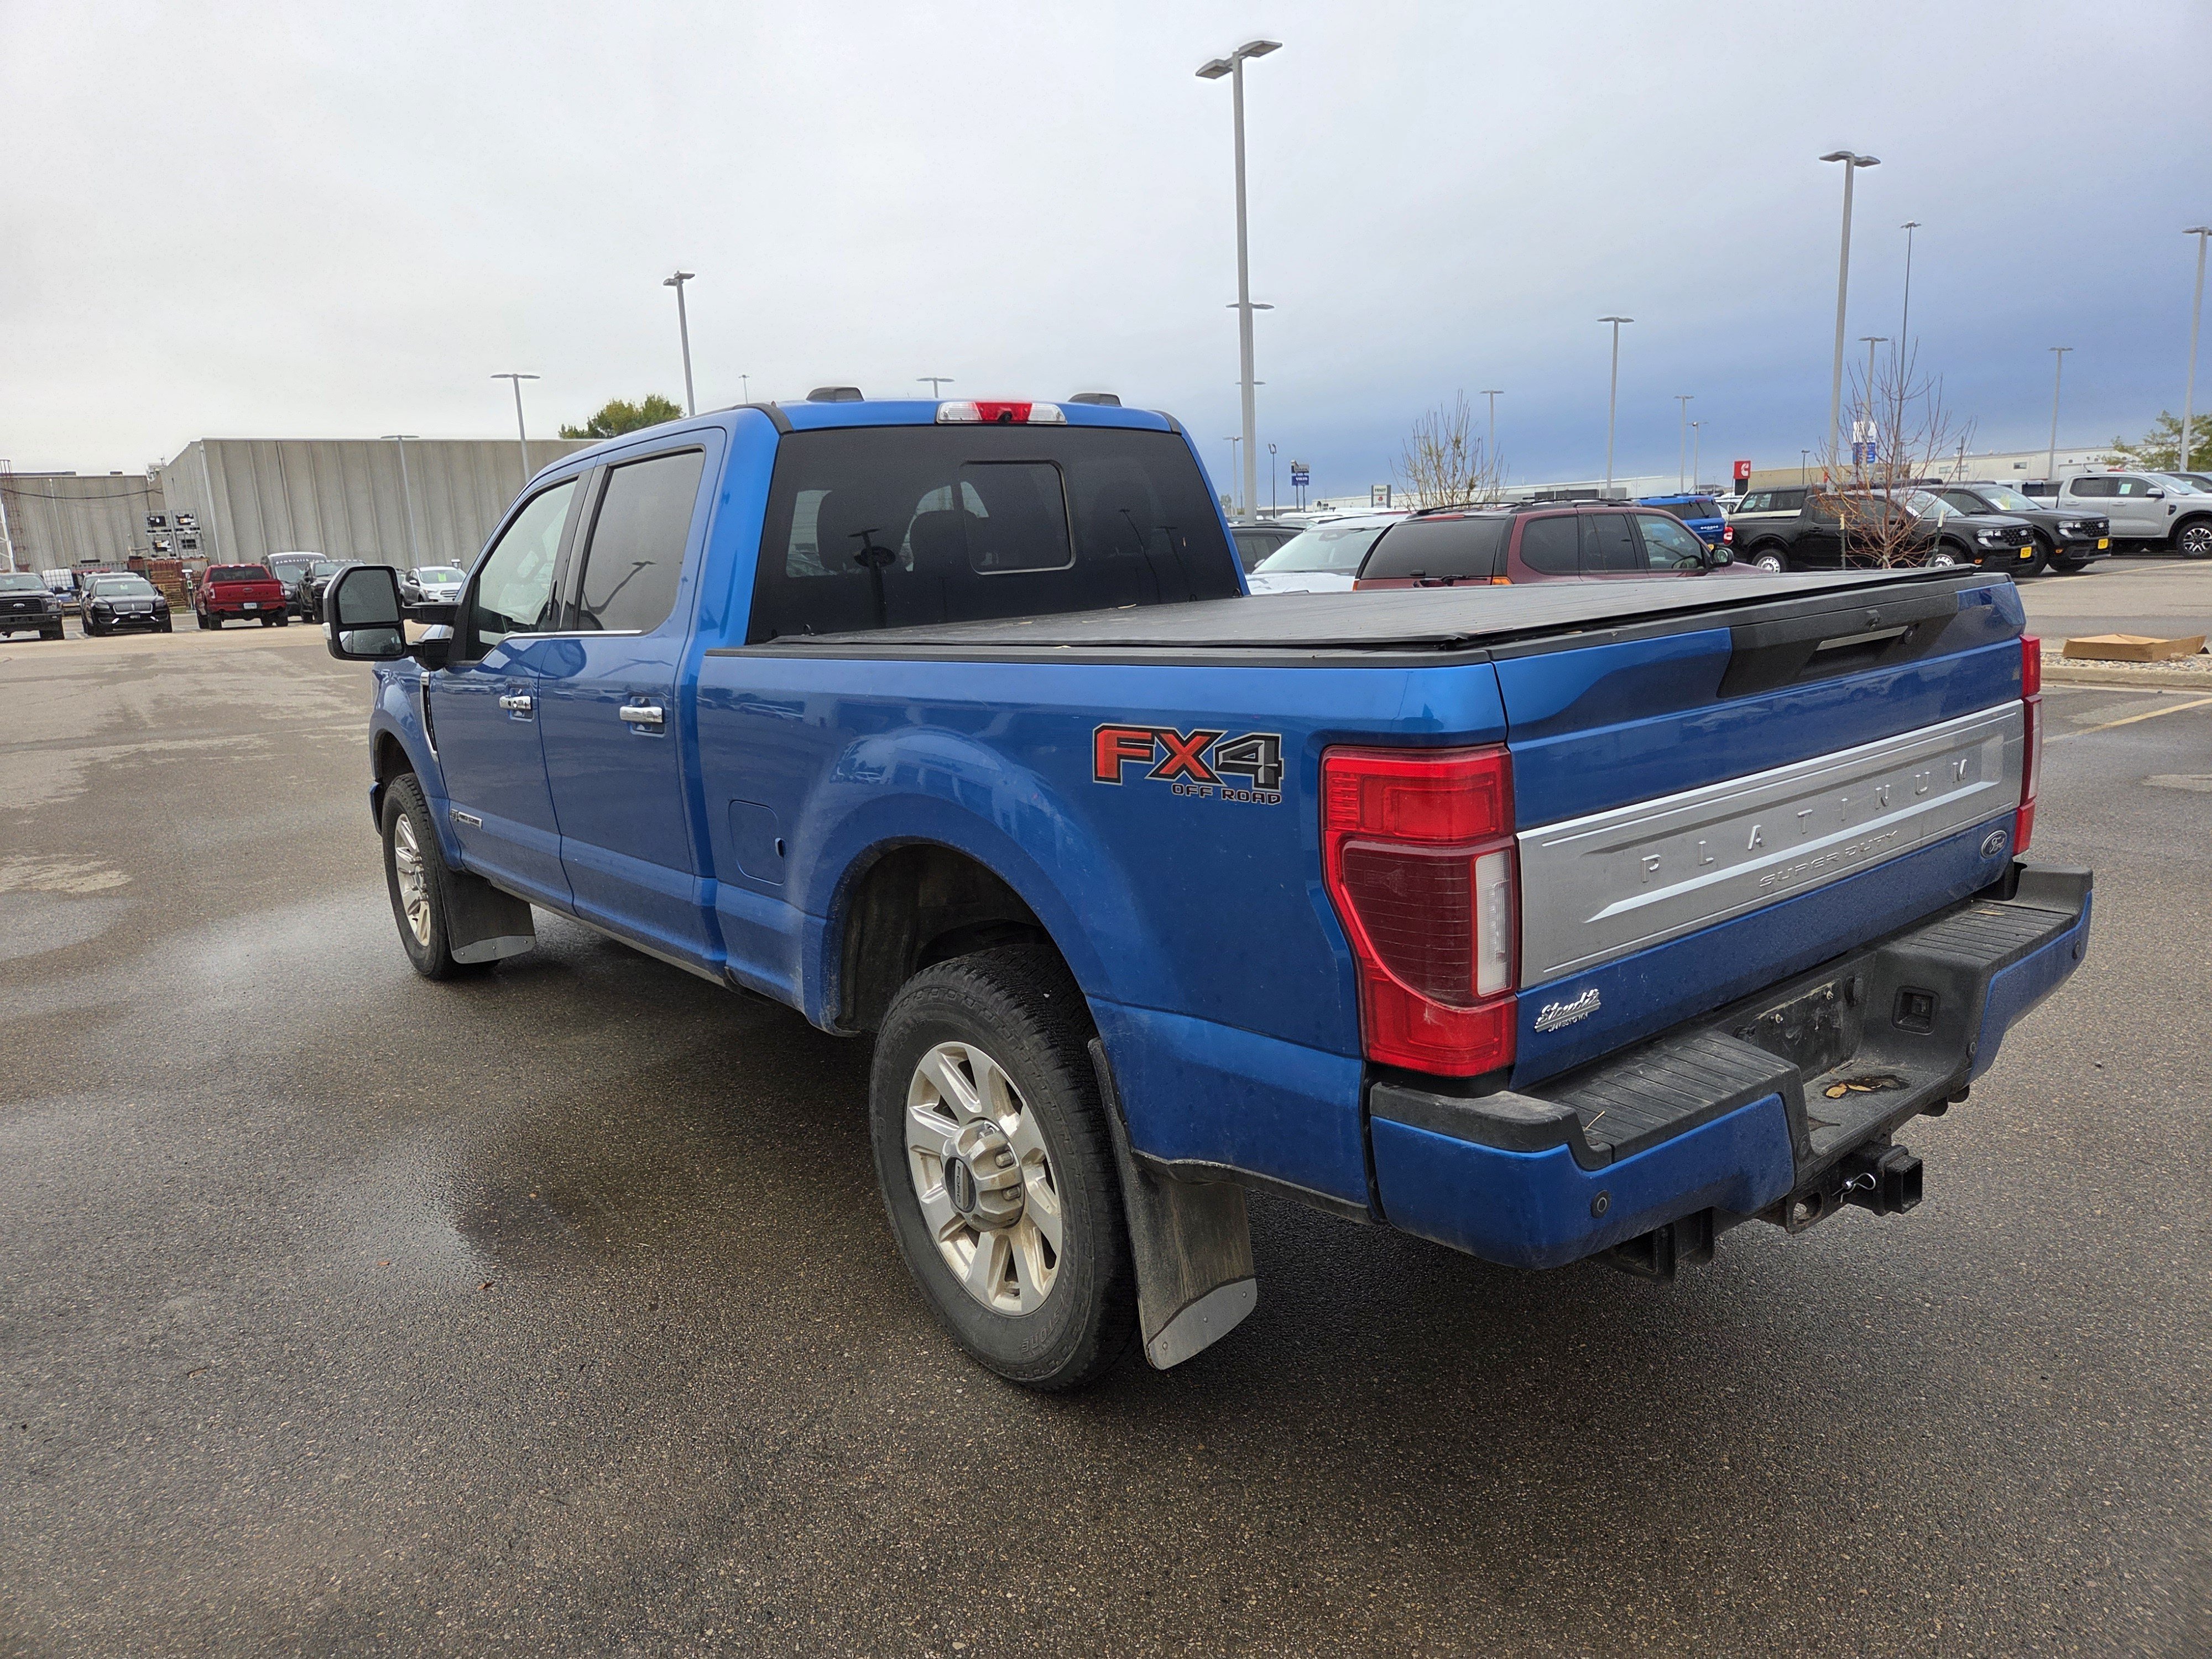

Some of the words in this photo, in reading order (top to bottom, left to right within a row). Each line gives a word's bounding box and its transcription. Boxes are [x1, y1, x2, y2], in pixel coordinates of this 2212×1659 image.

[1093, 723, 1284, 792] FX4
[1171, 783, 1213, 798] OFF
[1221, 788, 1282, 805] ROAD
[1641, 759, 1968, 883] PLATINUM
[1759, 852, 1839, 887] SUPER
[1845, 830, 1898, 856] DUTY
